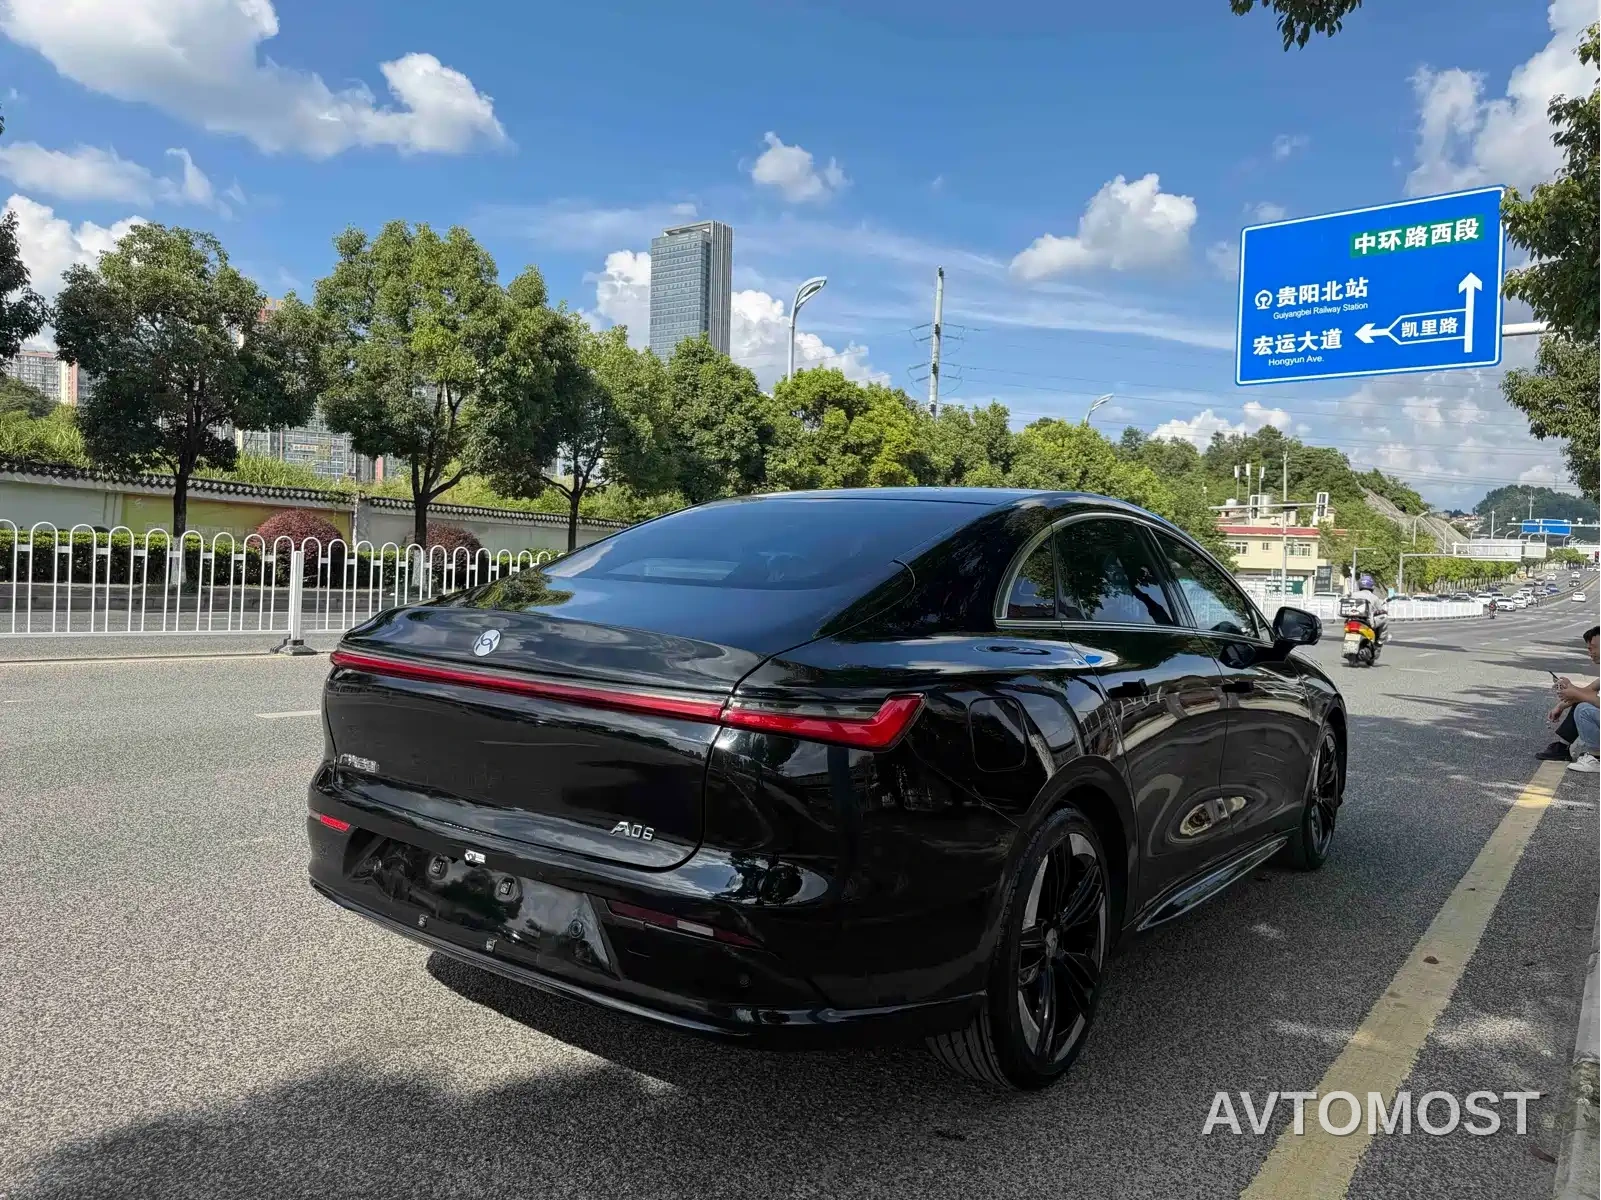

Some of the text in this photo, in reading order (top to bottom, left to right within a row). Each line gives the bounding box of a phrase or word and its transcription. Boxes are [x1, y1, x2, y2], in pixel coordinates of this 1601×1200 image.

[1354, 217, 1480, 255] 中环路西段
[1276, 276, 1369, 308] 贵阳北站
[1273, 302, 1369, 320] Guiyangbei Railway Station
[1401, 317, 1459, 338] 凯里路
[1253, 327, 1343, 356] 宏运大道
[1268, 354, 1325, 366] Hongyun Ave.
[610, 821, 655, 841] A06
